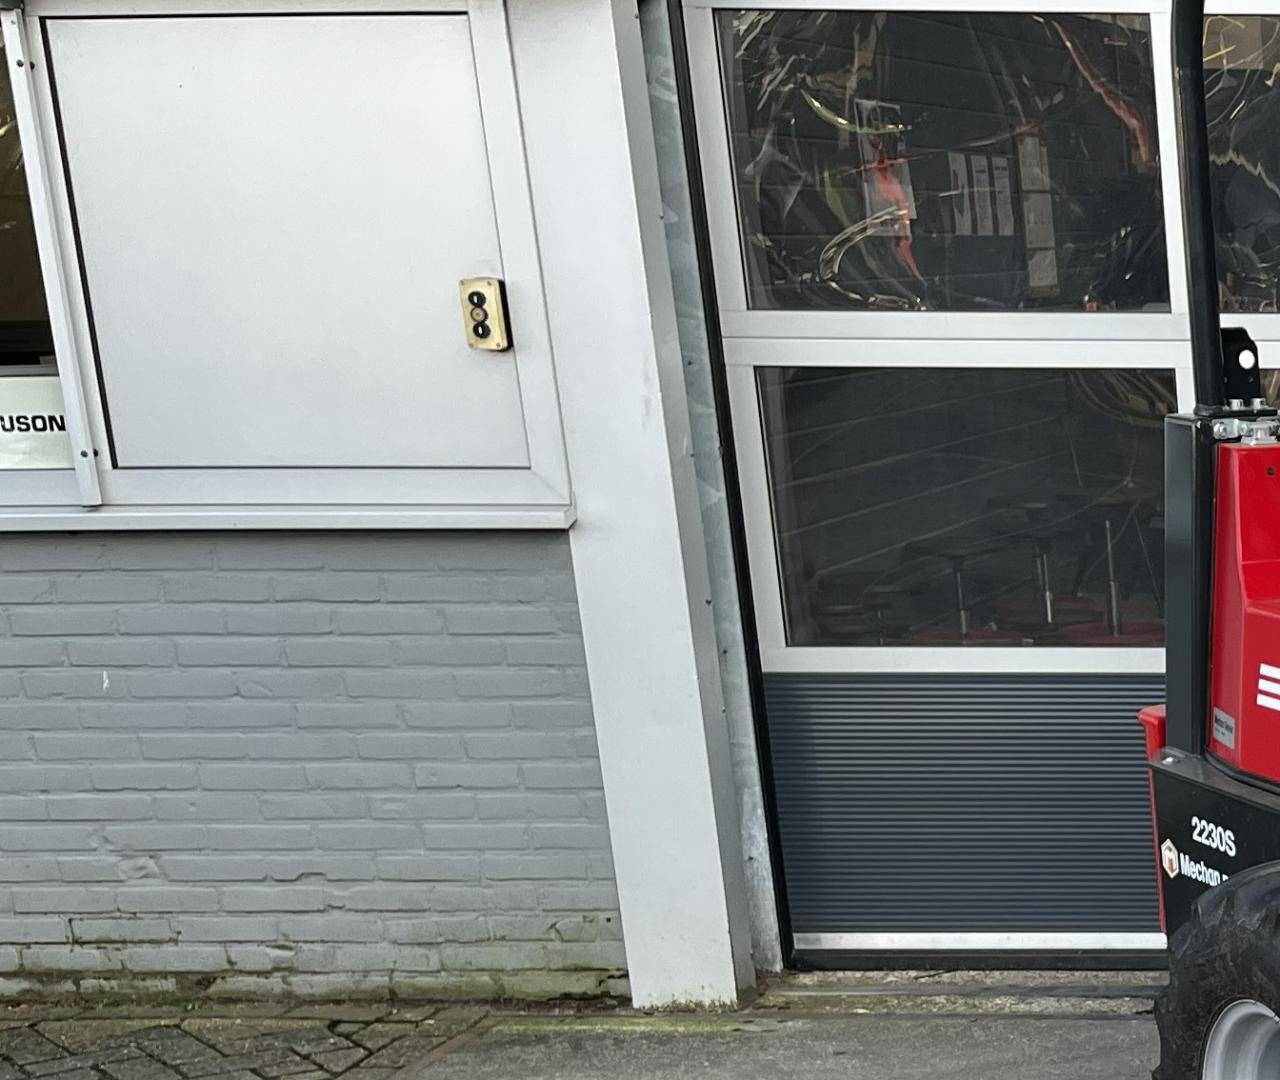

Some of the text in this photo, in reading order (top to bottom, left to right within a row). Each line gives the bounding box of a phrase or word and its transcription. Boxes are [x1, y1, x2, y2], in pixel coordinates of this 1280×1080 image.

[0, 414, 66, 432] USON
[1191, 816, 1237, 857] 2230S
[1180, 852, 1221, 887] Mechan
